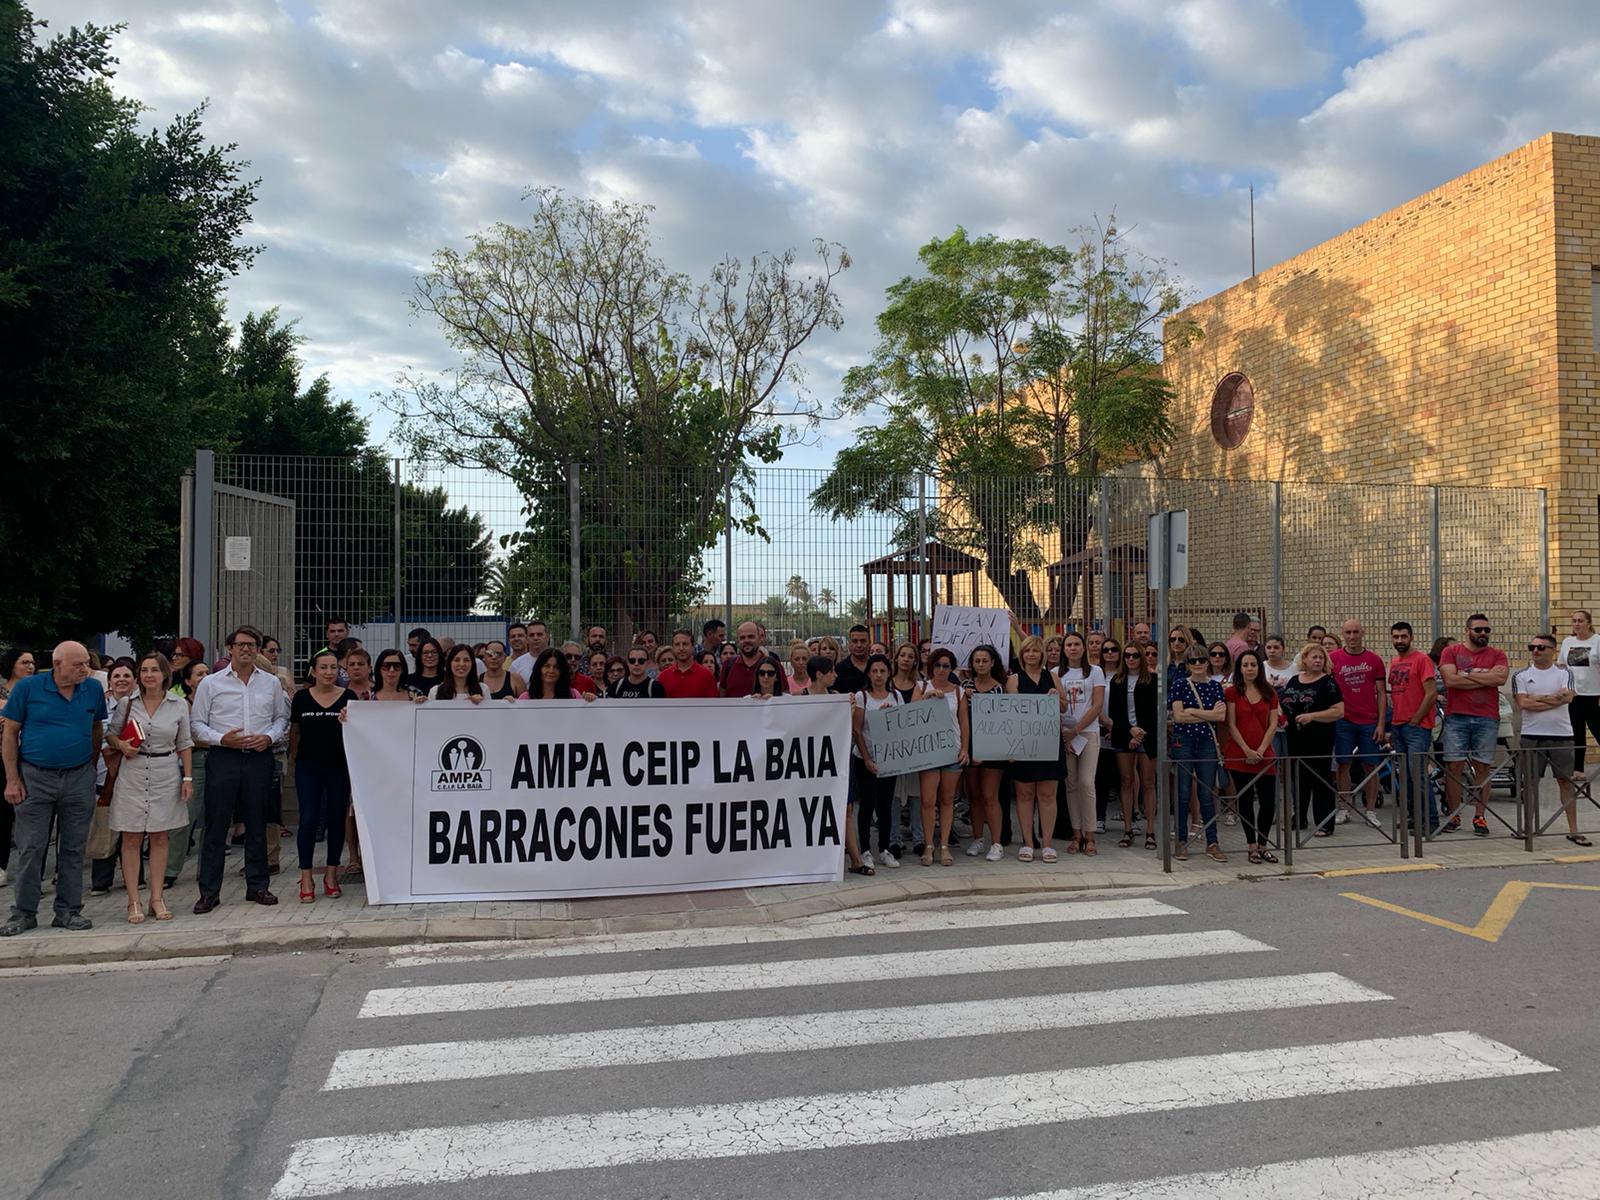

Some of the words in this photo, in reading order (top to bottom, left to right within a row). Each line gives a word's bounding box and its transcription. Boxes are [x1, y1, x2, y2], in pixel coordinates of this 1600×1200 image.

[885, 707, 937, 732] FUERA
[974, 719, 1013, 736] AULAS
[1020, 719, 1059, 737] DIGNAS
[873, 728, 955, 762] BARRACONES
[437, 771, 483, 783] AMPA
[511, 741, 612, 789] AMPA
[623, 739, 701, 787] CEIP
[712, 740, 755, 784] LA
[766, 736, 838, 780] BAIA
[428, 803, 673, 865] BARRACONES
[686, 798, 792, 856] FUERA
[799, 796, 841, 847] YA
